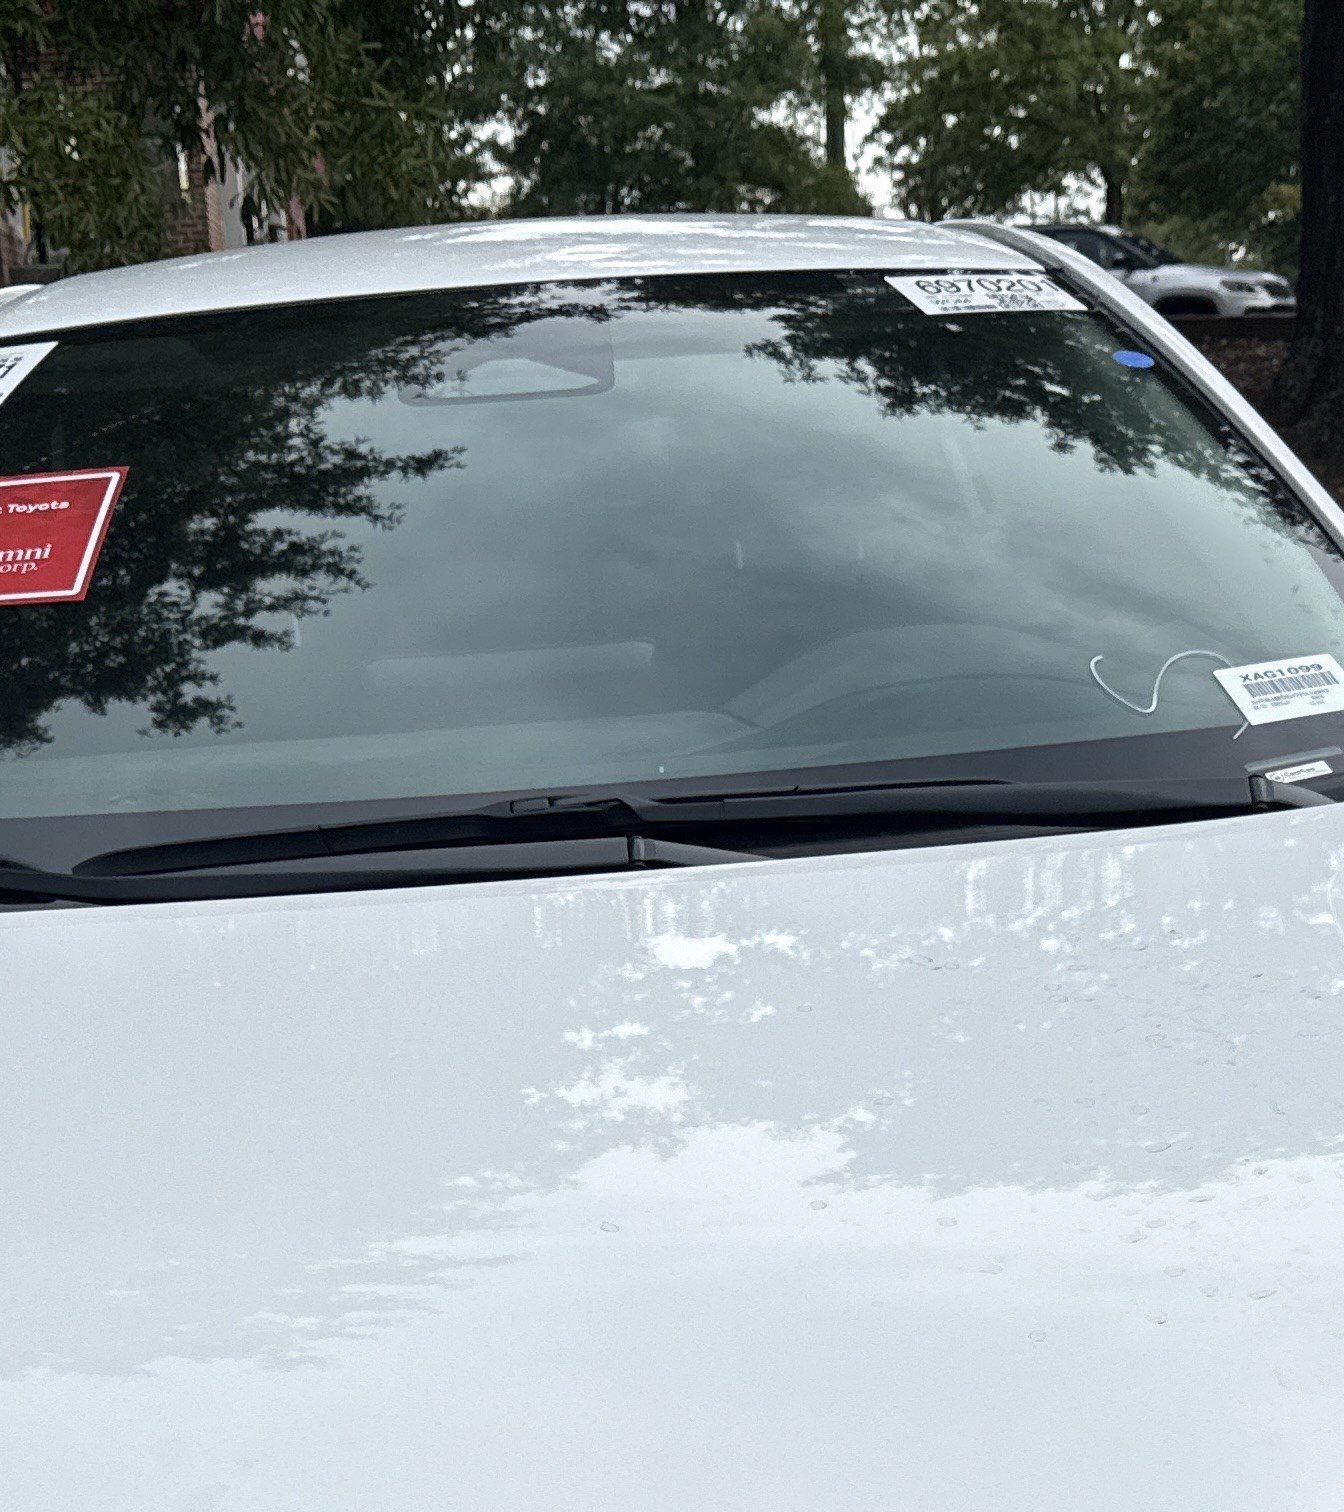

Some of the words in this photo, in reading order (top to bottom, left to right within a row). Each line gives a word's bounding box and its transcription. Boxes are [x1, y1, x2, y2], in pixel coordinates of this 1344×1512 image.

[915, 278, 1059, 294] 6970201
[7, 501, 69, 514] Toyota
[1239, 663, 1323, 682] XAG1099
